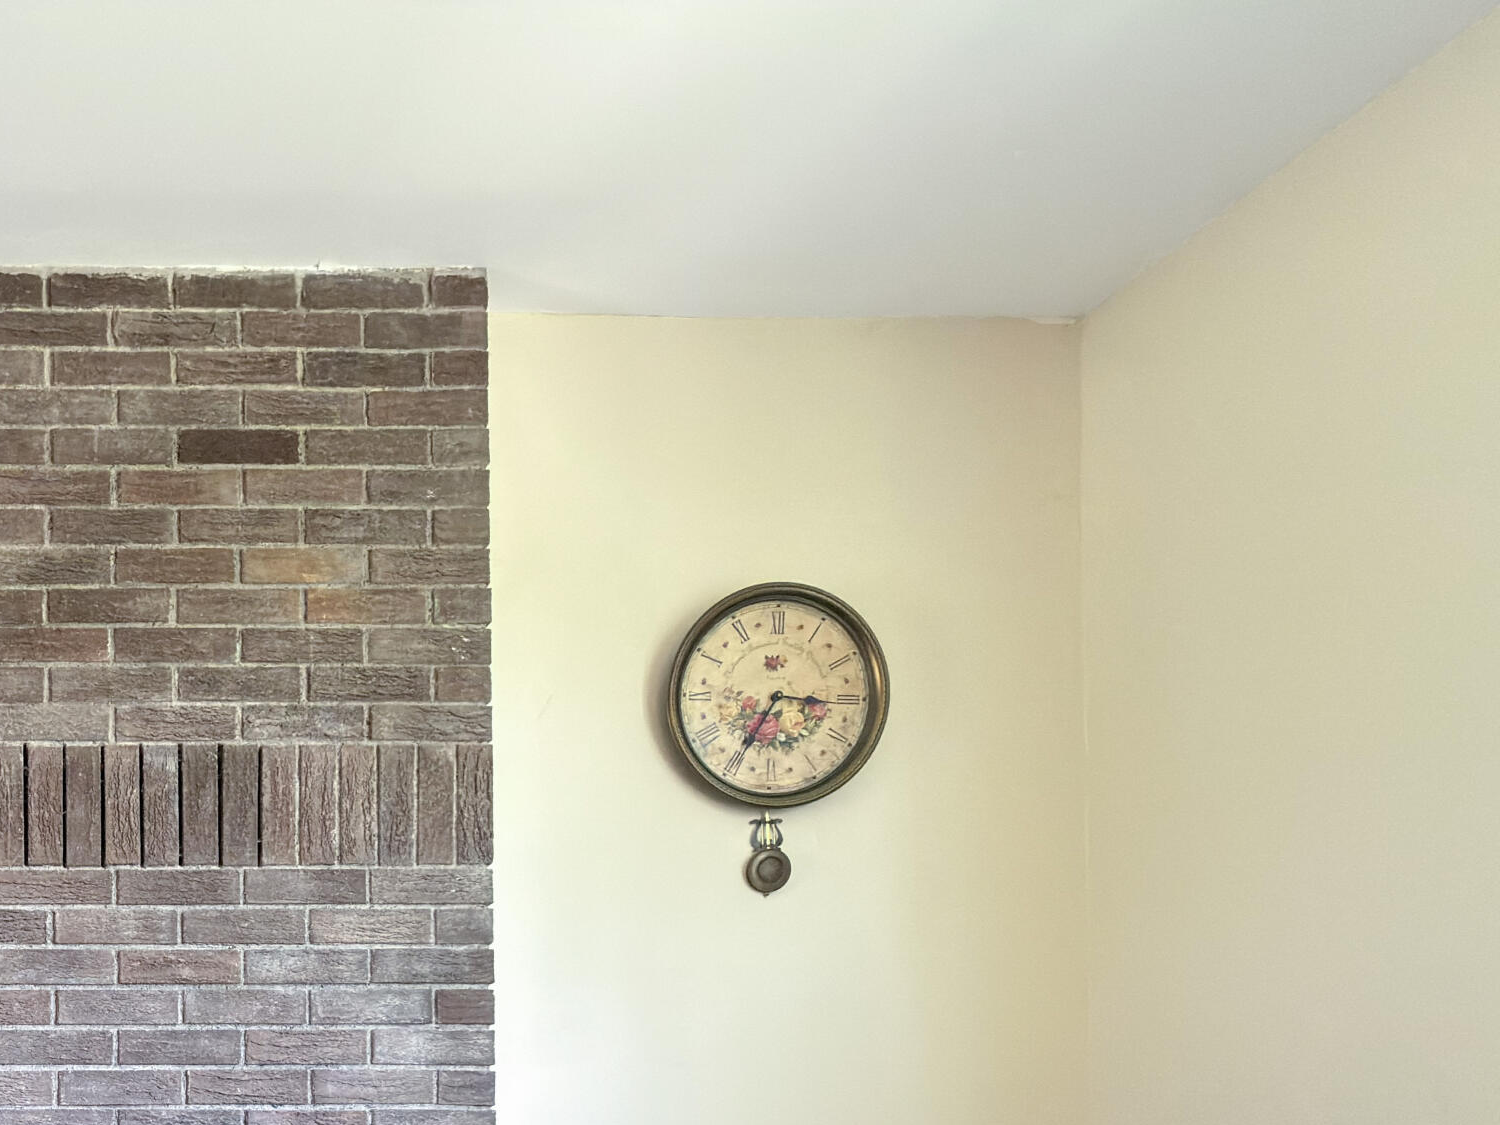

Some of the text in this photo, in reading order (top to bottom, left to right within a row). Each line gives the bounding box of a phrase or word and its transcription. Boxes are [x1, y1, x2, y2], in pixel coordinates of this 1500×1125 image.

[771, 611, 785, 634] XII
[808, 623, 822, 642] I
[829, 655, 851, 670] II
[837, 695, 860, 704] III
